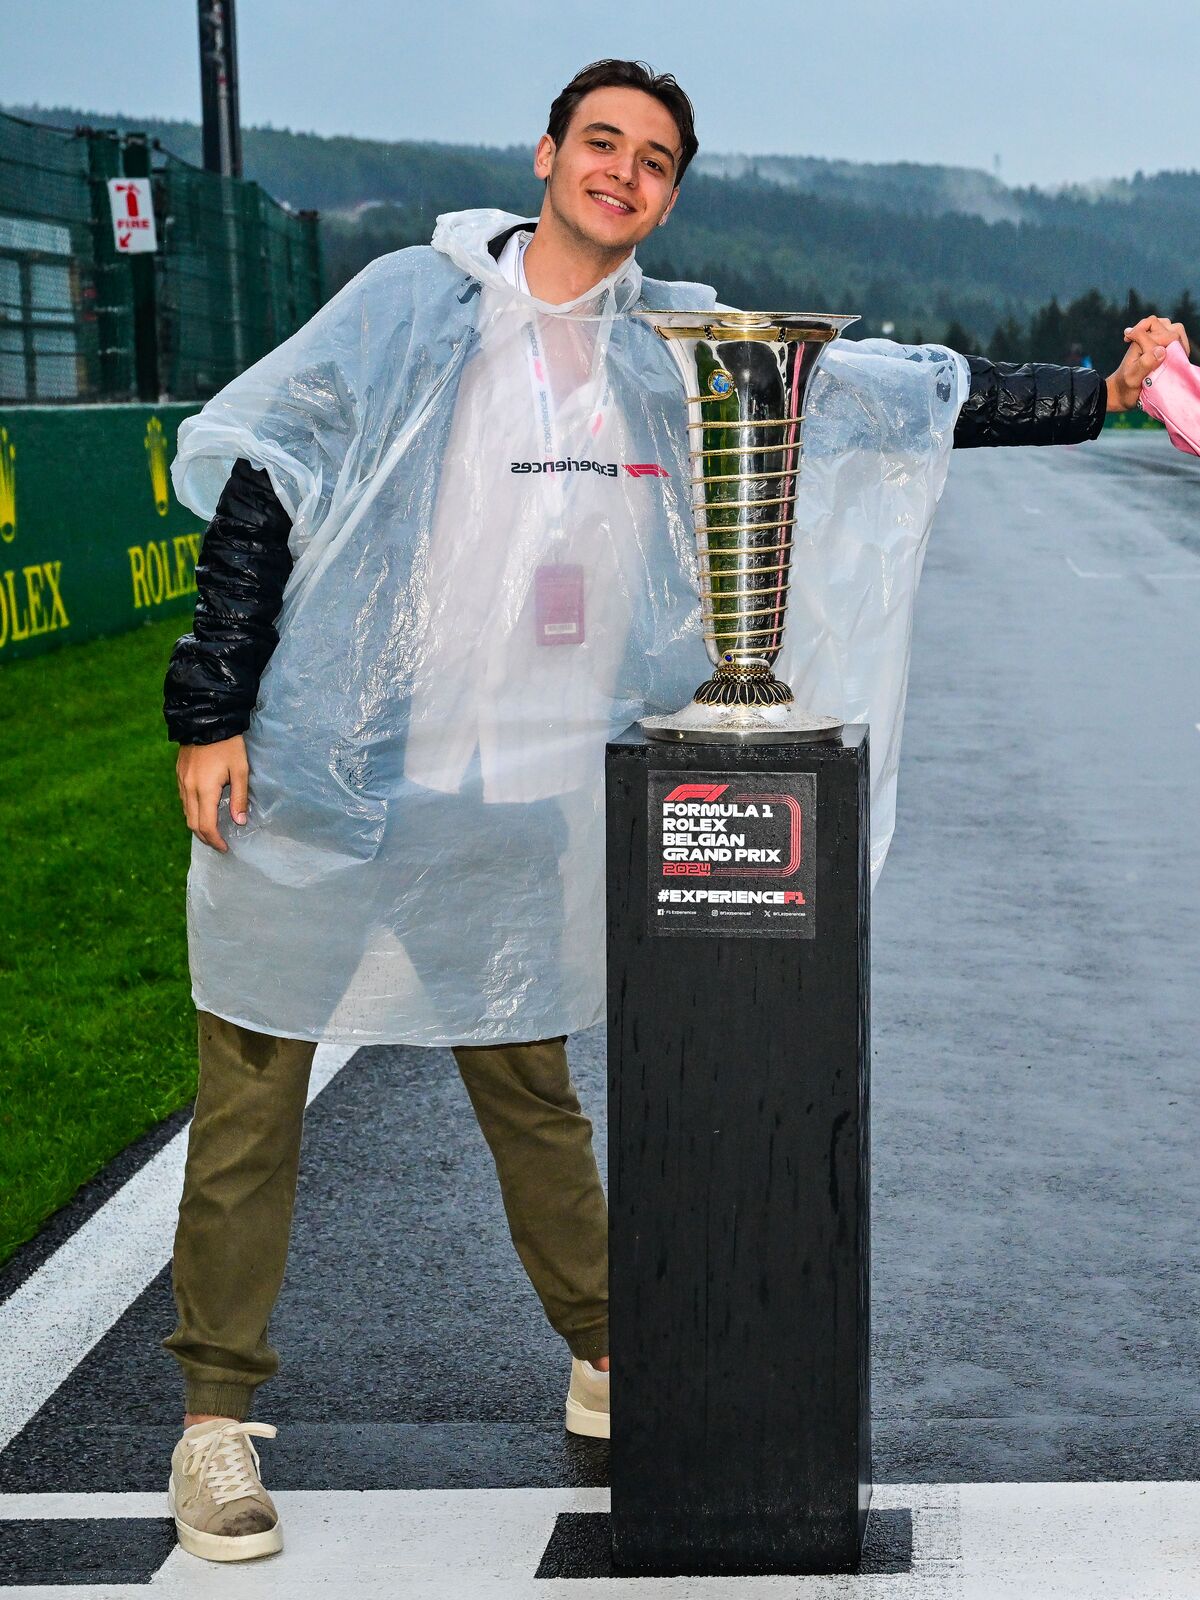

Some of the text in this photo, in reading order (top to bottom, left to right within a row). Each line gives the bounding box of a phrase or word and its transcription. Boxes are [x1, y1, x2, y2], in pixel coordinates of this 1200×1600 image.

[116, 219, 150, 230] FIRE
[663, 803, 773, 818] FORMULA 1
[663, 818, 728, 832] ROLEX
[663, 833, 745, 847] BELGIAN
[663, 848, 781, 862] GRAND PRIX
[663, 863, 711, 875] 2024
[657, 889, 806, 904] #EXPERIENCEF1
